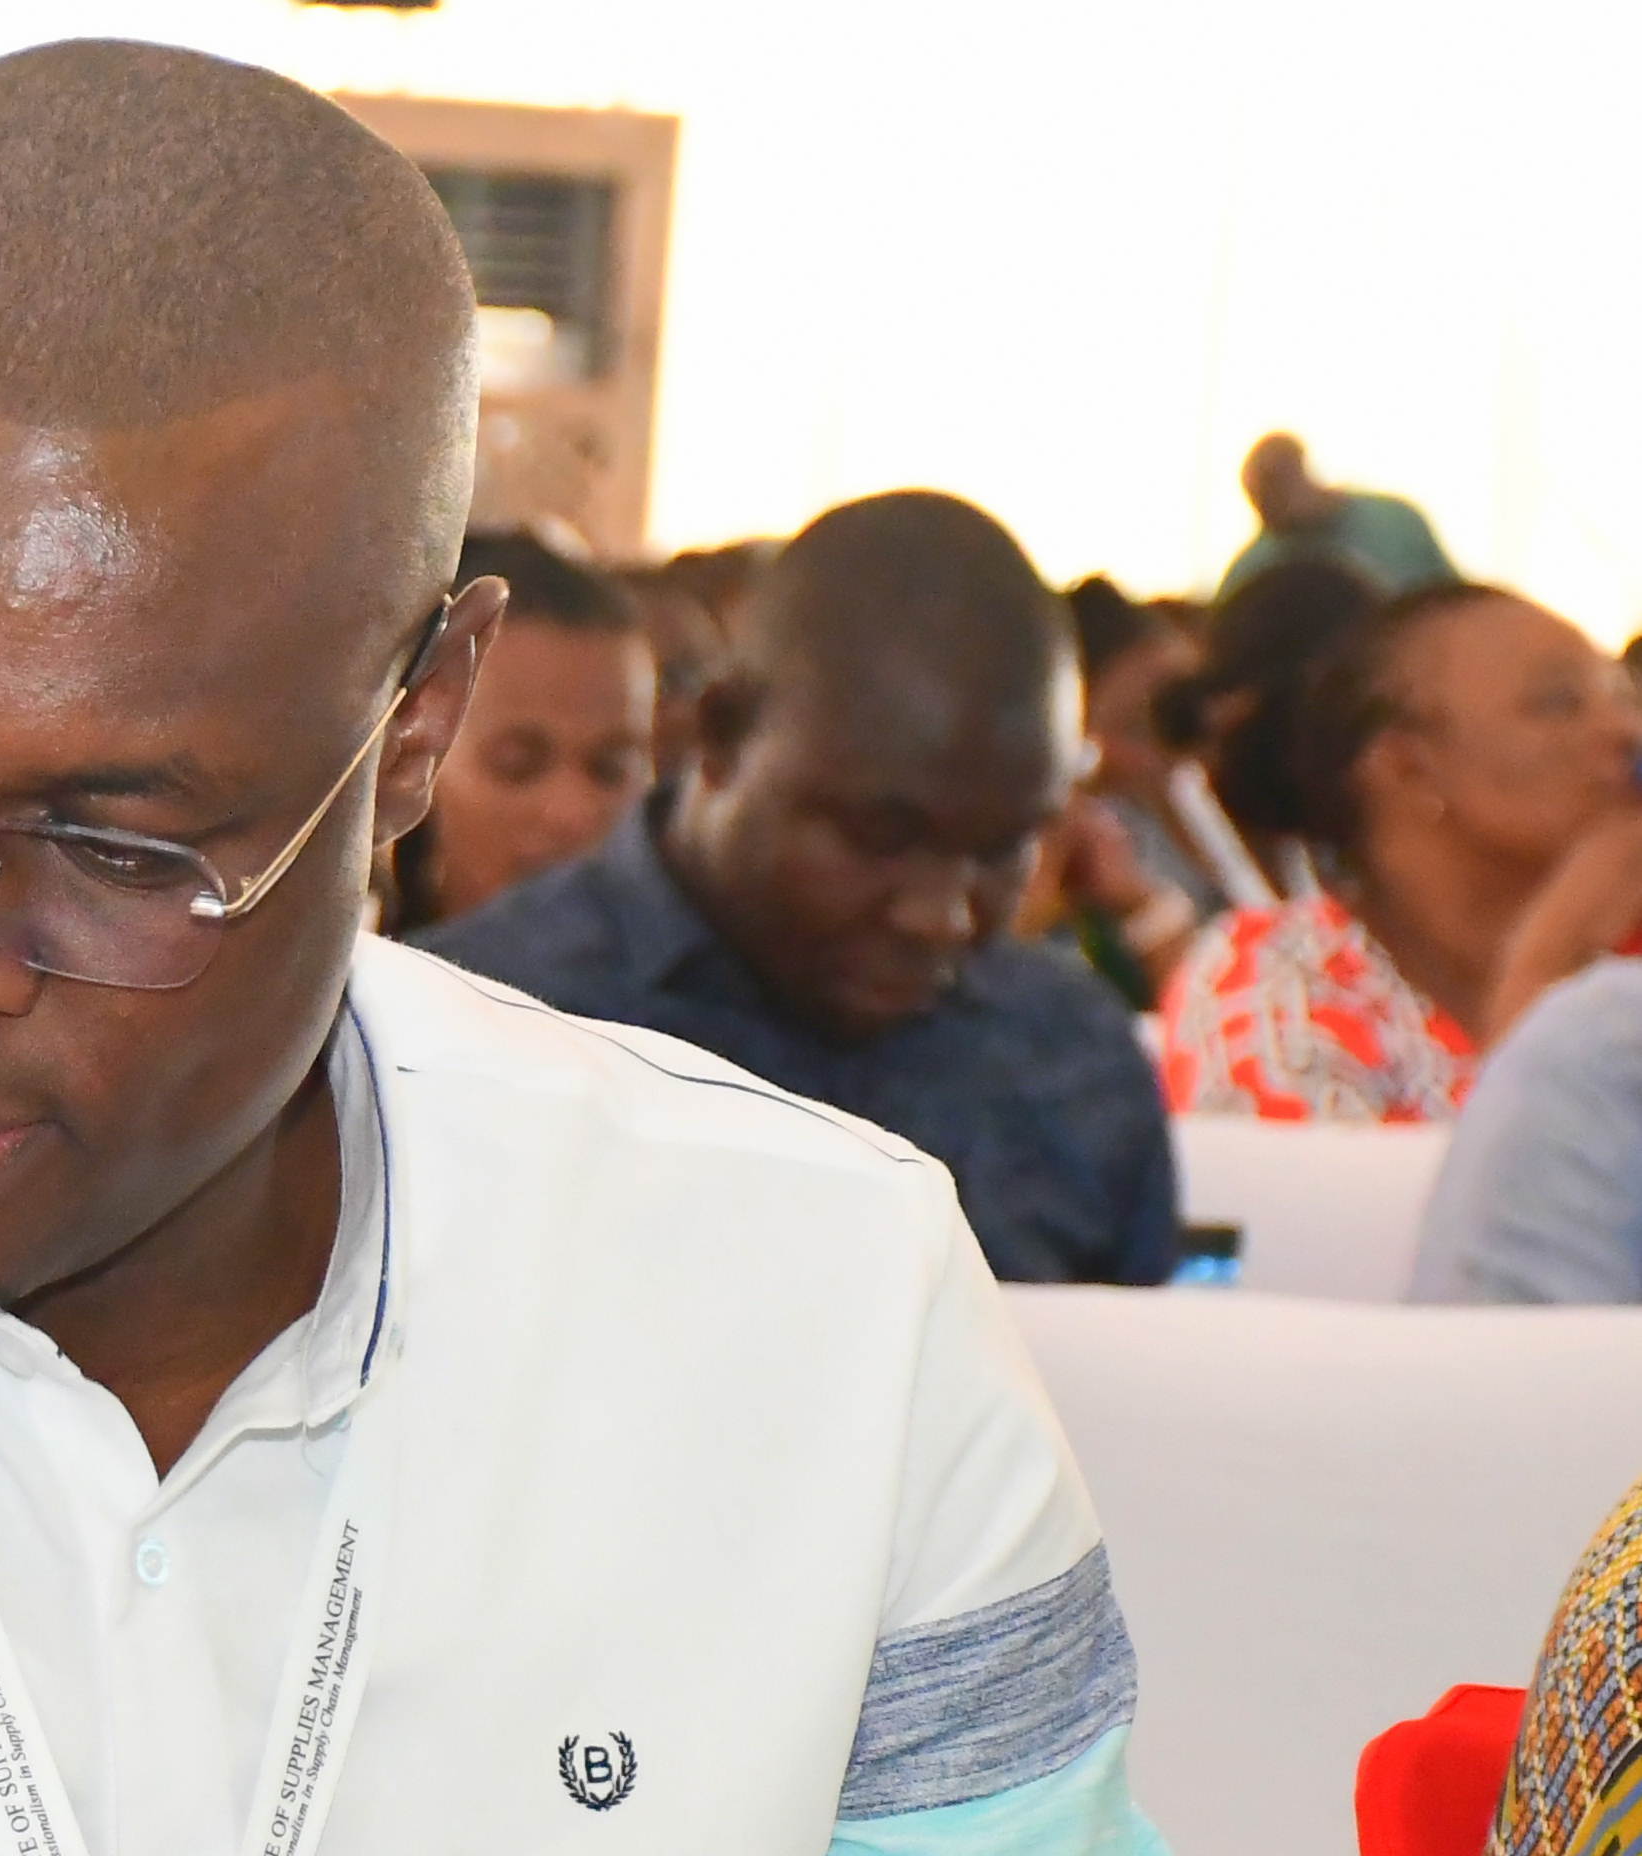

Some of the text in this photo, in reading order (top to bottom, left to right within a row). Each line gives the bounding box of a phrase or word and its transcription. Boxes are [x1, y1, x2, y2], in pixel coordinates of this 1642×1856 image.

[333, 1586, 364, 1681] Management
[271, 1806, 291, 1839] OF
[281, 1695, 321, 1803] SUPPLIES
[307, 1518, 360, 1691] MANAGEMENT
[320, 1683, 342, 1728] Chain
[0, 1711, 27, 1763] Supply
[306, 1730, 331, 1781] Supply
[19, 1764, 33, 1780] in
[584, 1746, 613, 1783] B
[301, 1785, 314, 1801] in
[5, 1803, 31, 1834] OF
